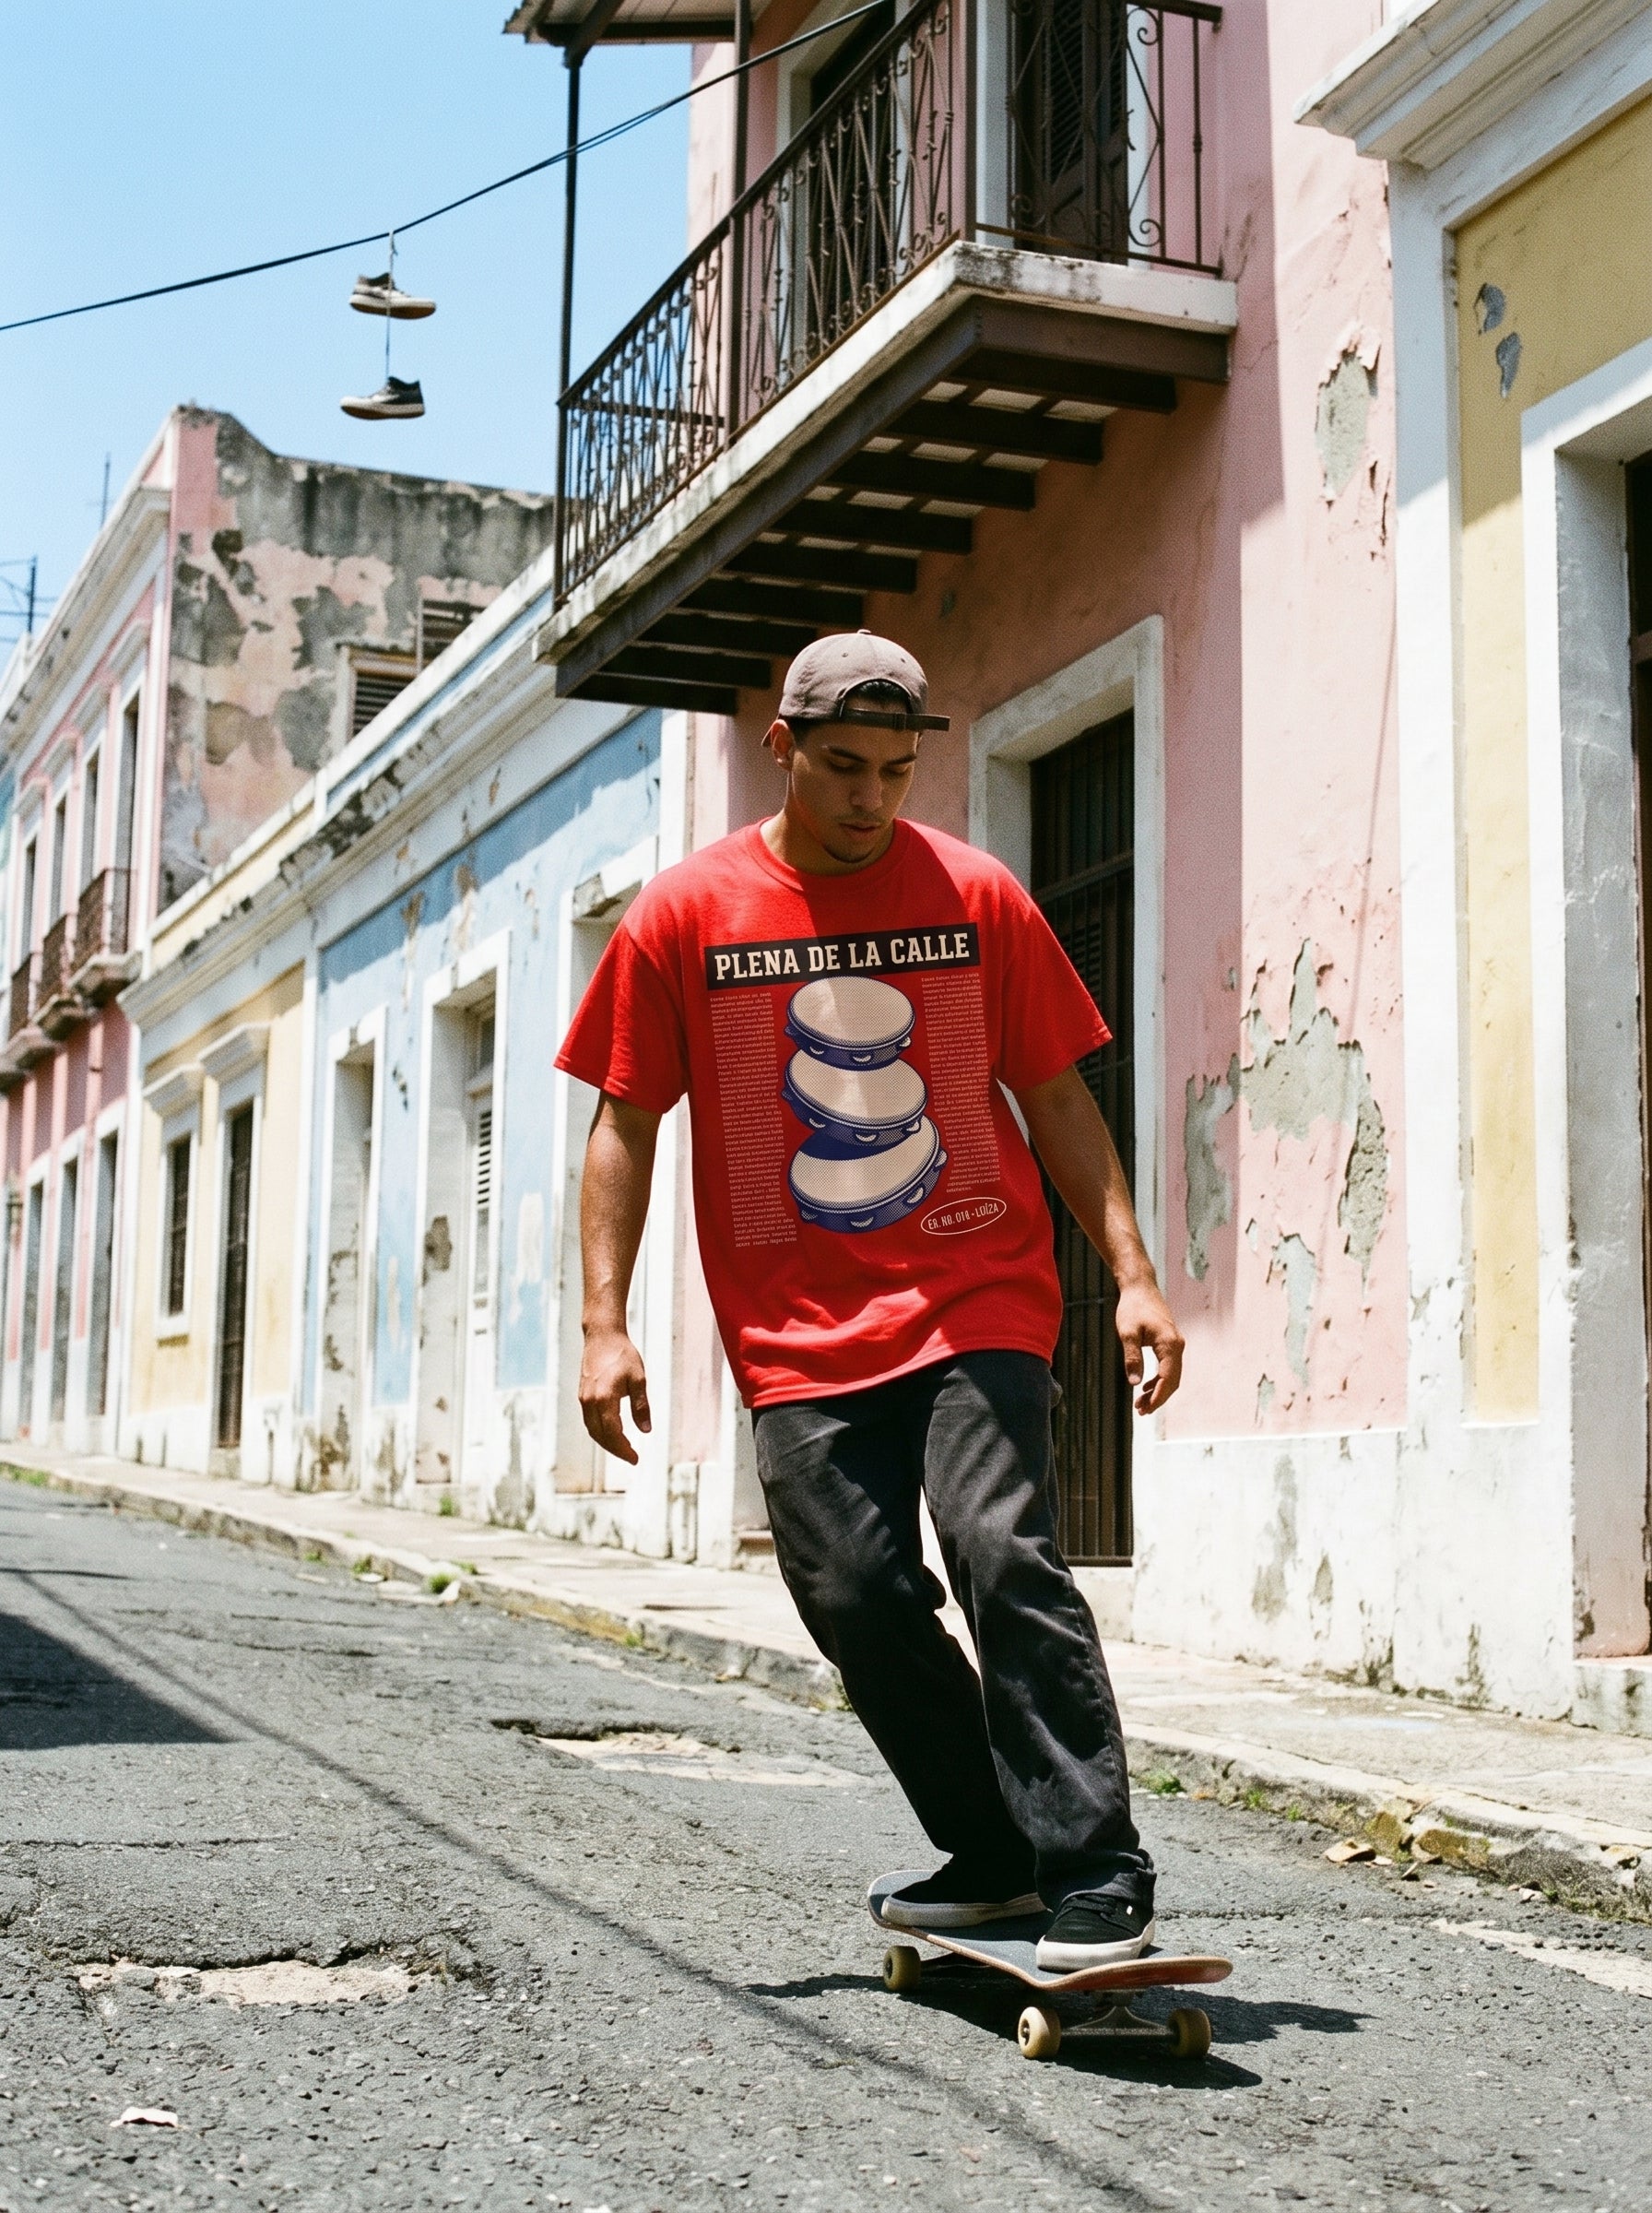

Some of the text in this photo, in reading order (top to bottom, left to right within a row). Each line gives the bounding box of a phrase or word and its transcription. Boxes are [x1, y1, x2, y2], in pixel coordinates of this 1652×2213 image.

[714, 932, 970, 980] PLENA DE LA CALLE
